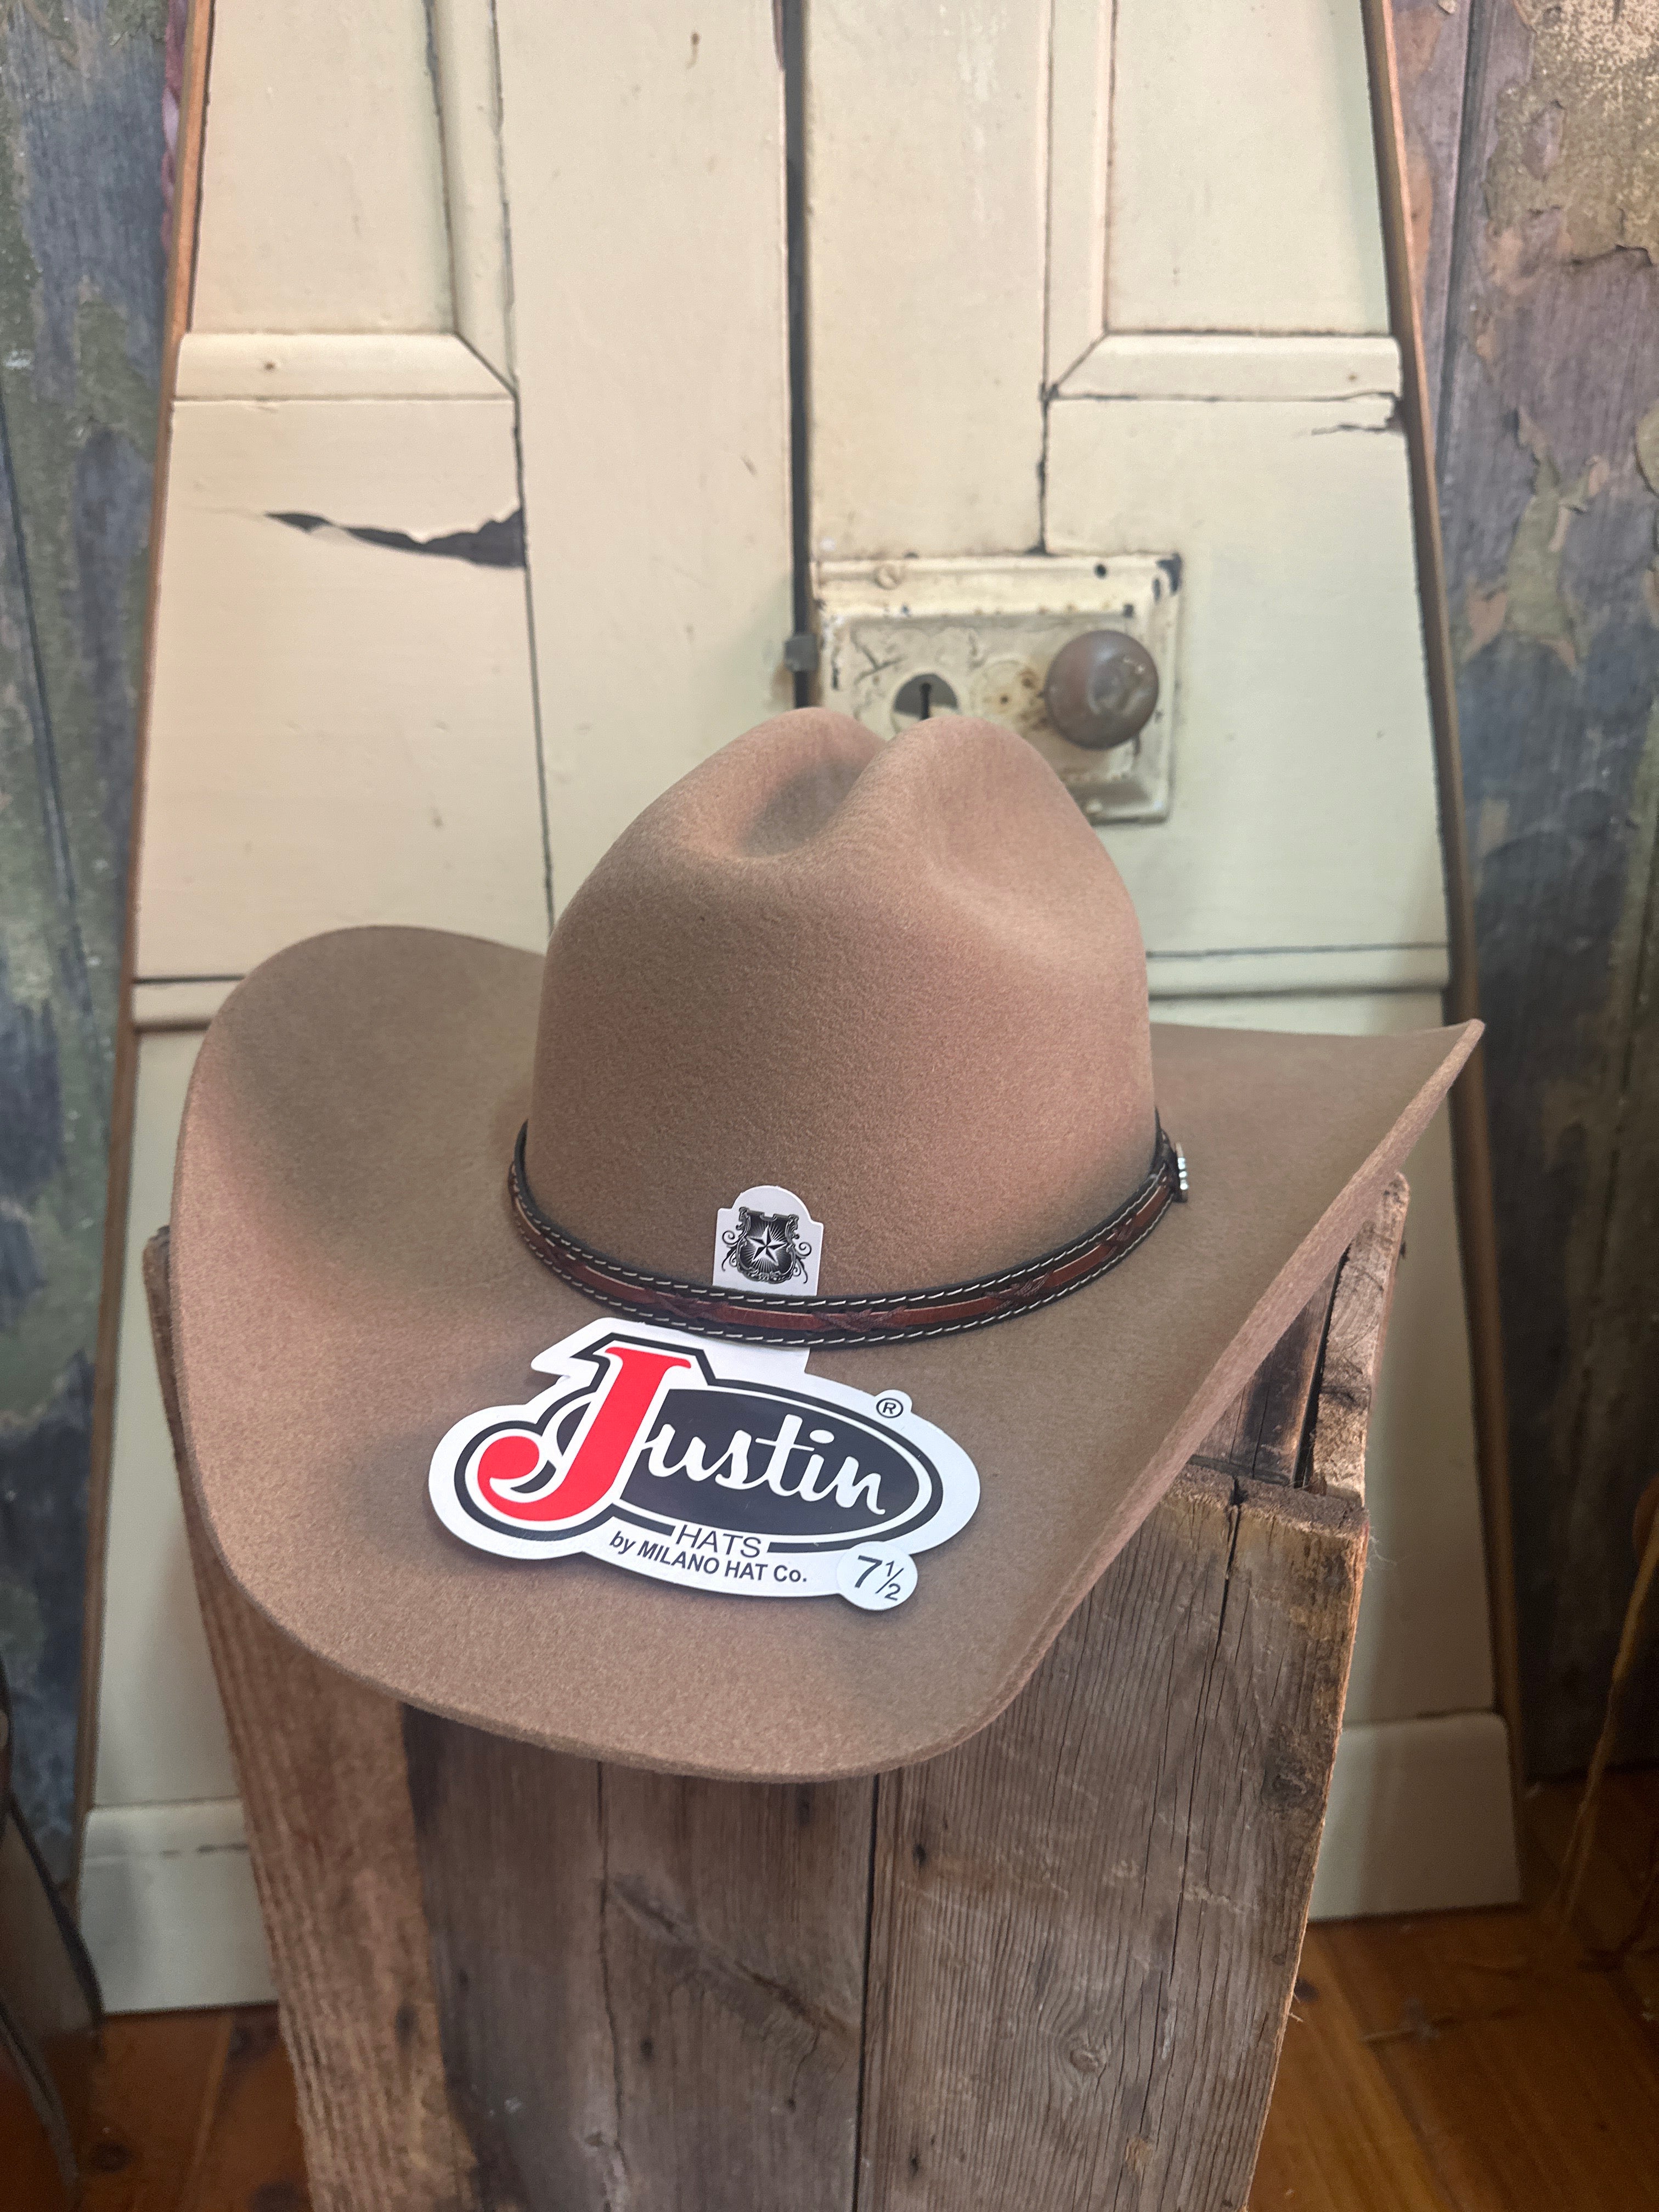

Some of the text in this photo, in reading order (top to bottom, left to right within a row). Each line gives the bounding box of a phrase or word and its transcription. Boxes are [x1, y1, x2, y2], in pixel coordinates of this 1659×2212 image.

[477, 1346, 886, 1522] Justin
[609, 1531, 807, 1583] by MILANO HAT Co.
[675, 1525, 762, 1558] HATS
